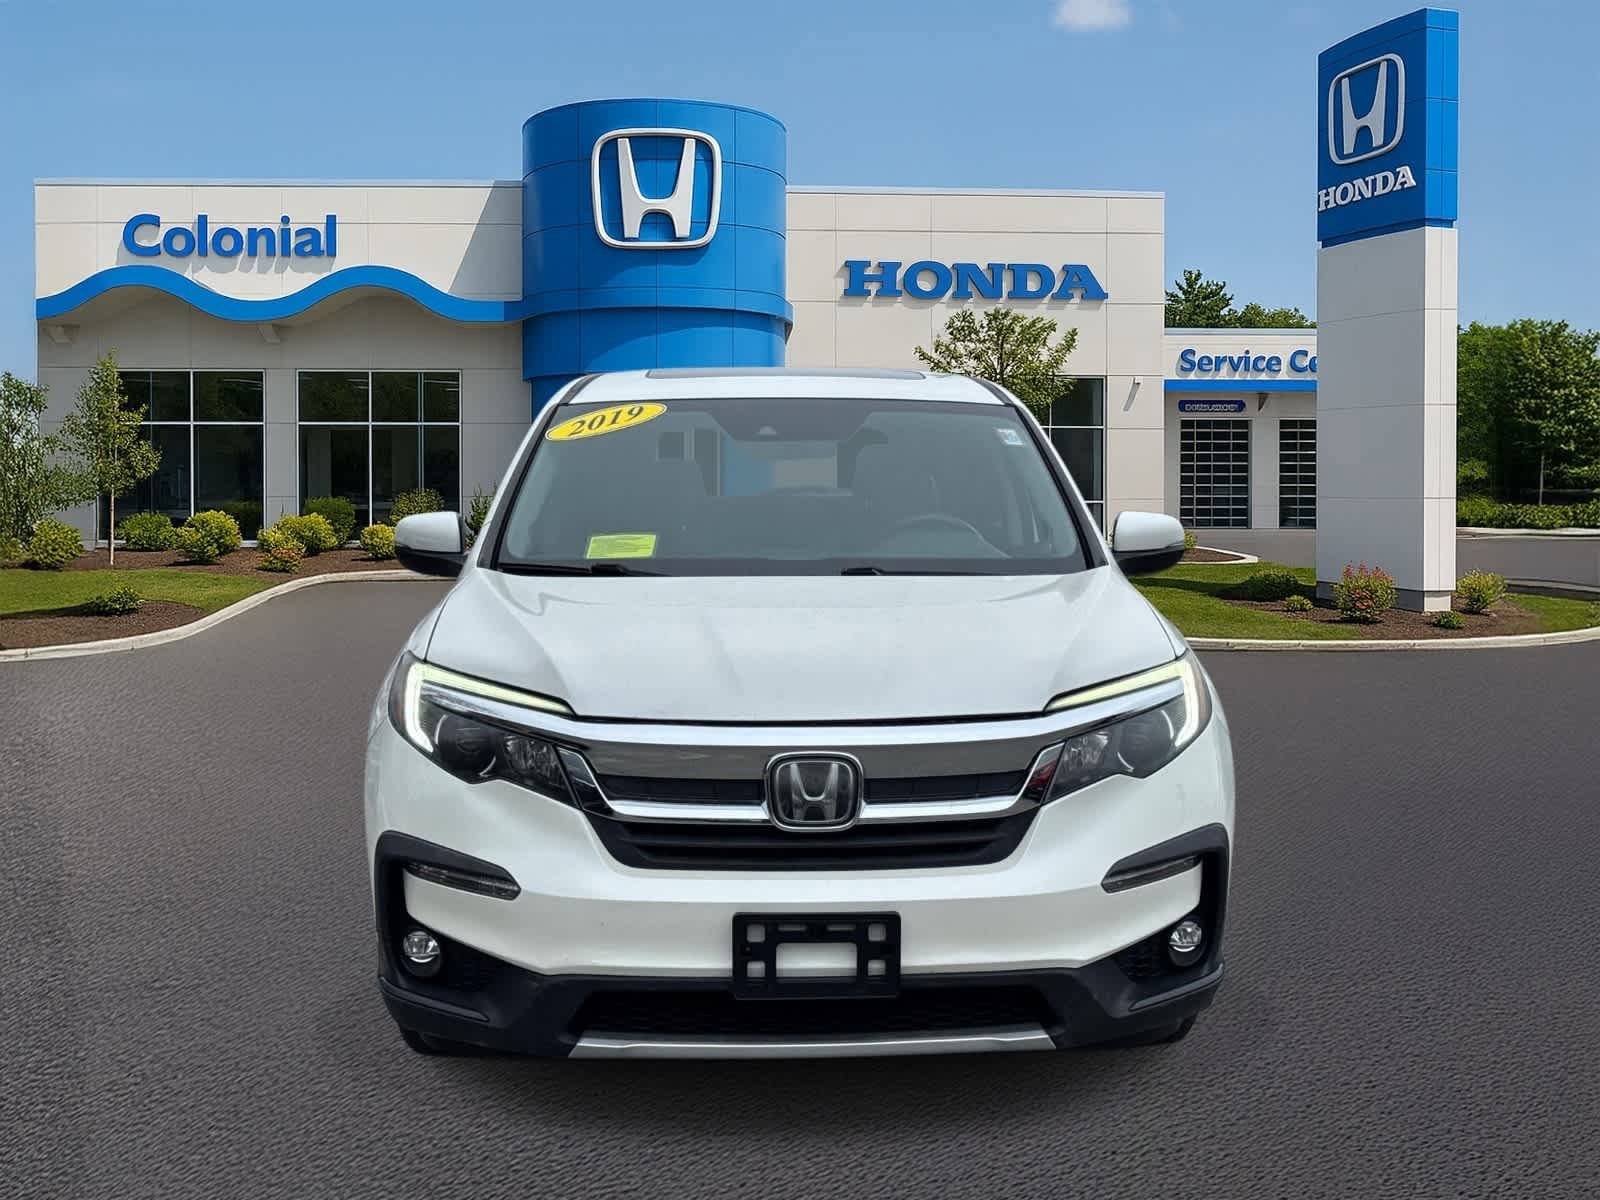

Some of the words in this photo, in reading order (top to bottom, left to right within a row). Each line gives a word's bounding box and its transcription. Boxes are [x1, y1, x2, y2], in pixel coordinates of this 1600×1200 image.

[1318, 165, 1416, 211] HONDA
[122, 213, 337, 257] Colonial
[843, 260, 1109, 300] HONDA
[1179, 348, 1282, 373] Service
[568, 405, 645, 436] 2019
